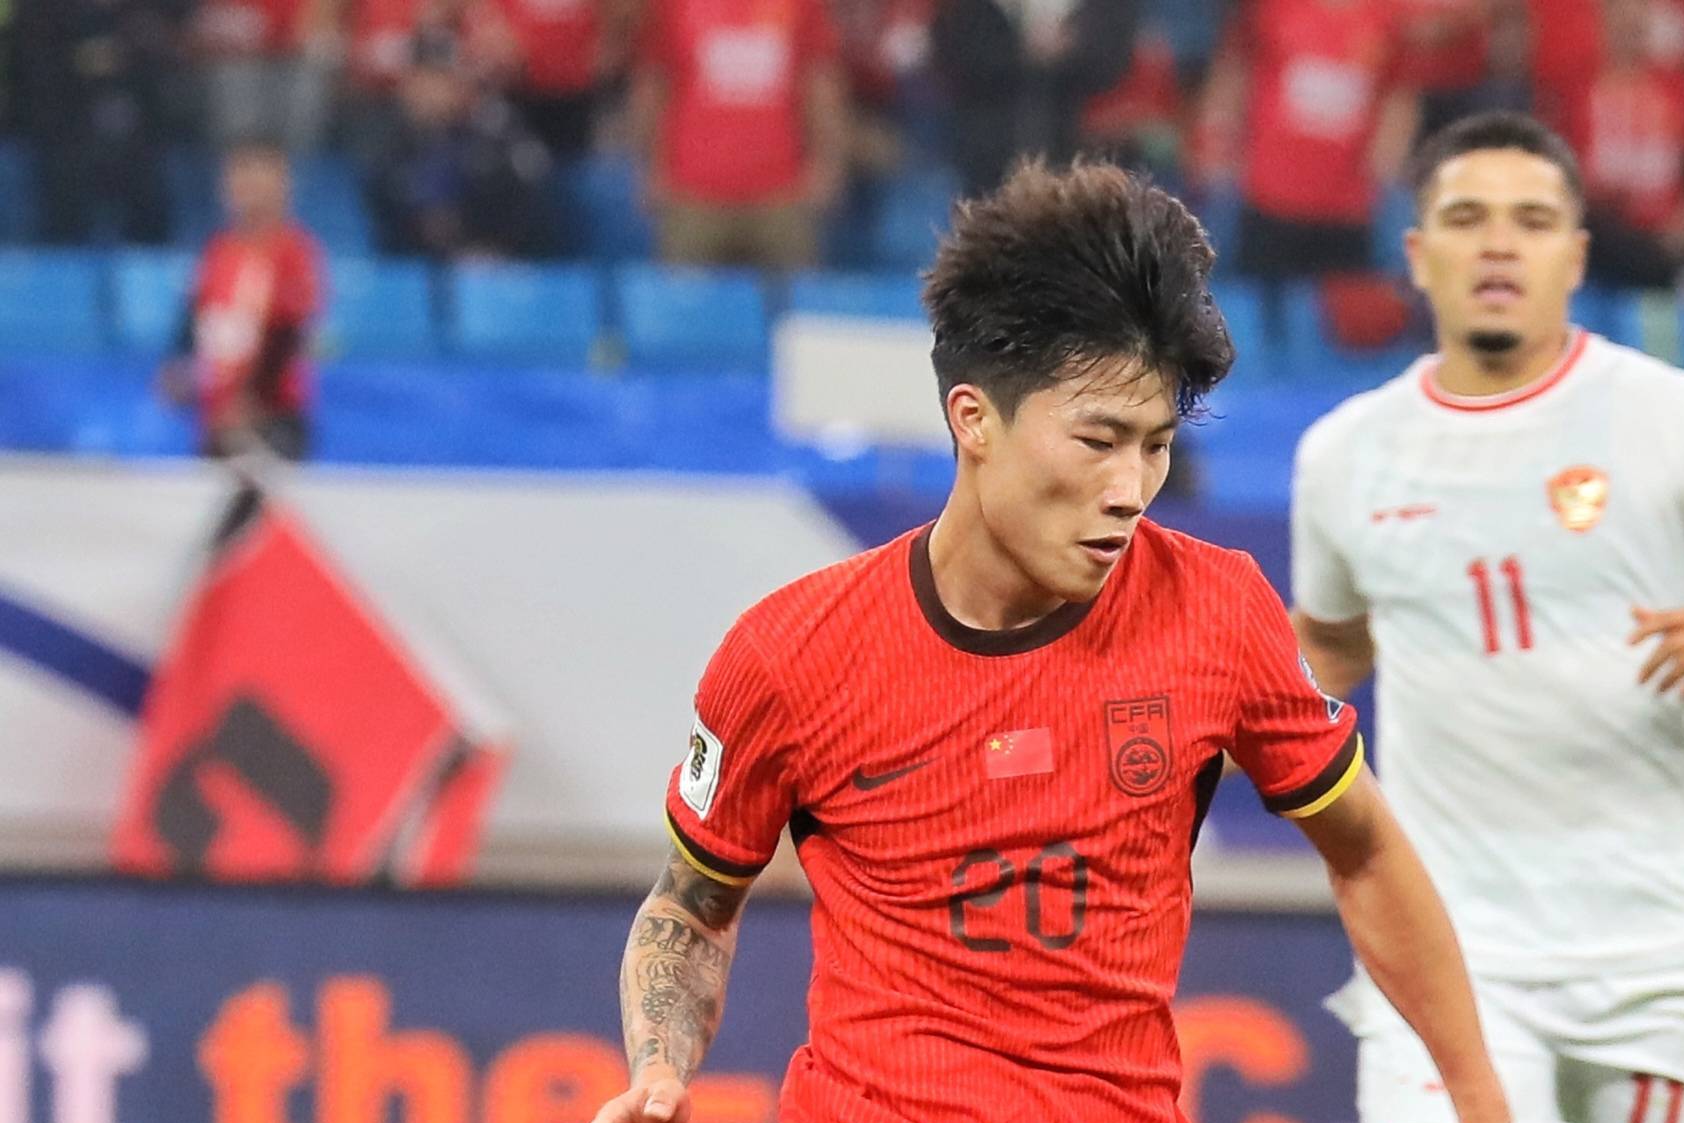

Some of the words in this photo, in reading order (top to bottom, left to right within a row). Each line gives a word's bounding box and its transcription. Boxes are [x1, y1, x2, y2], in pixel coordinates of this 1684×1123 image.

[1465, 553, 1535, 656] 11
[1110, 703, 1164, 724] CFA
[948, 841, 1088, 952] 20
